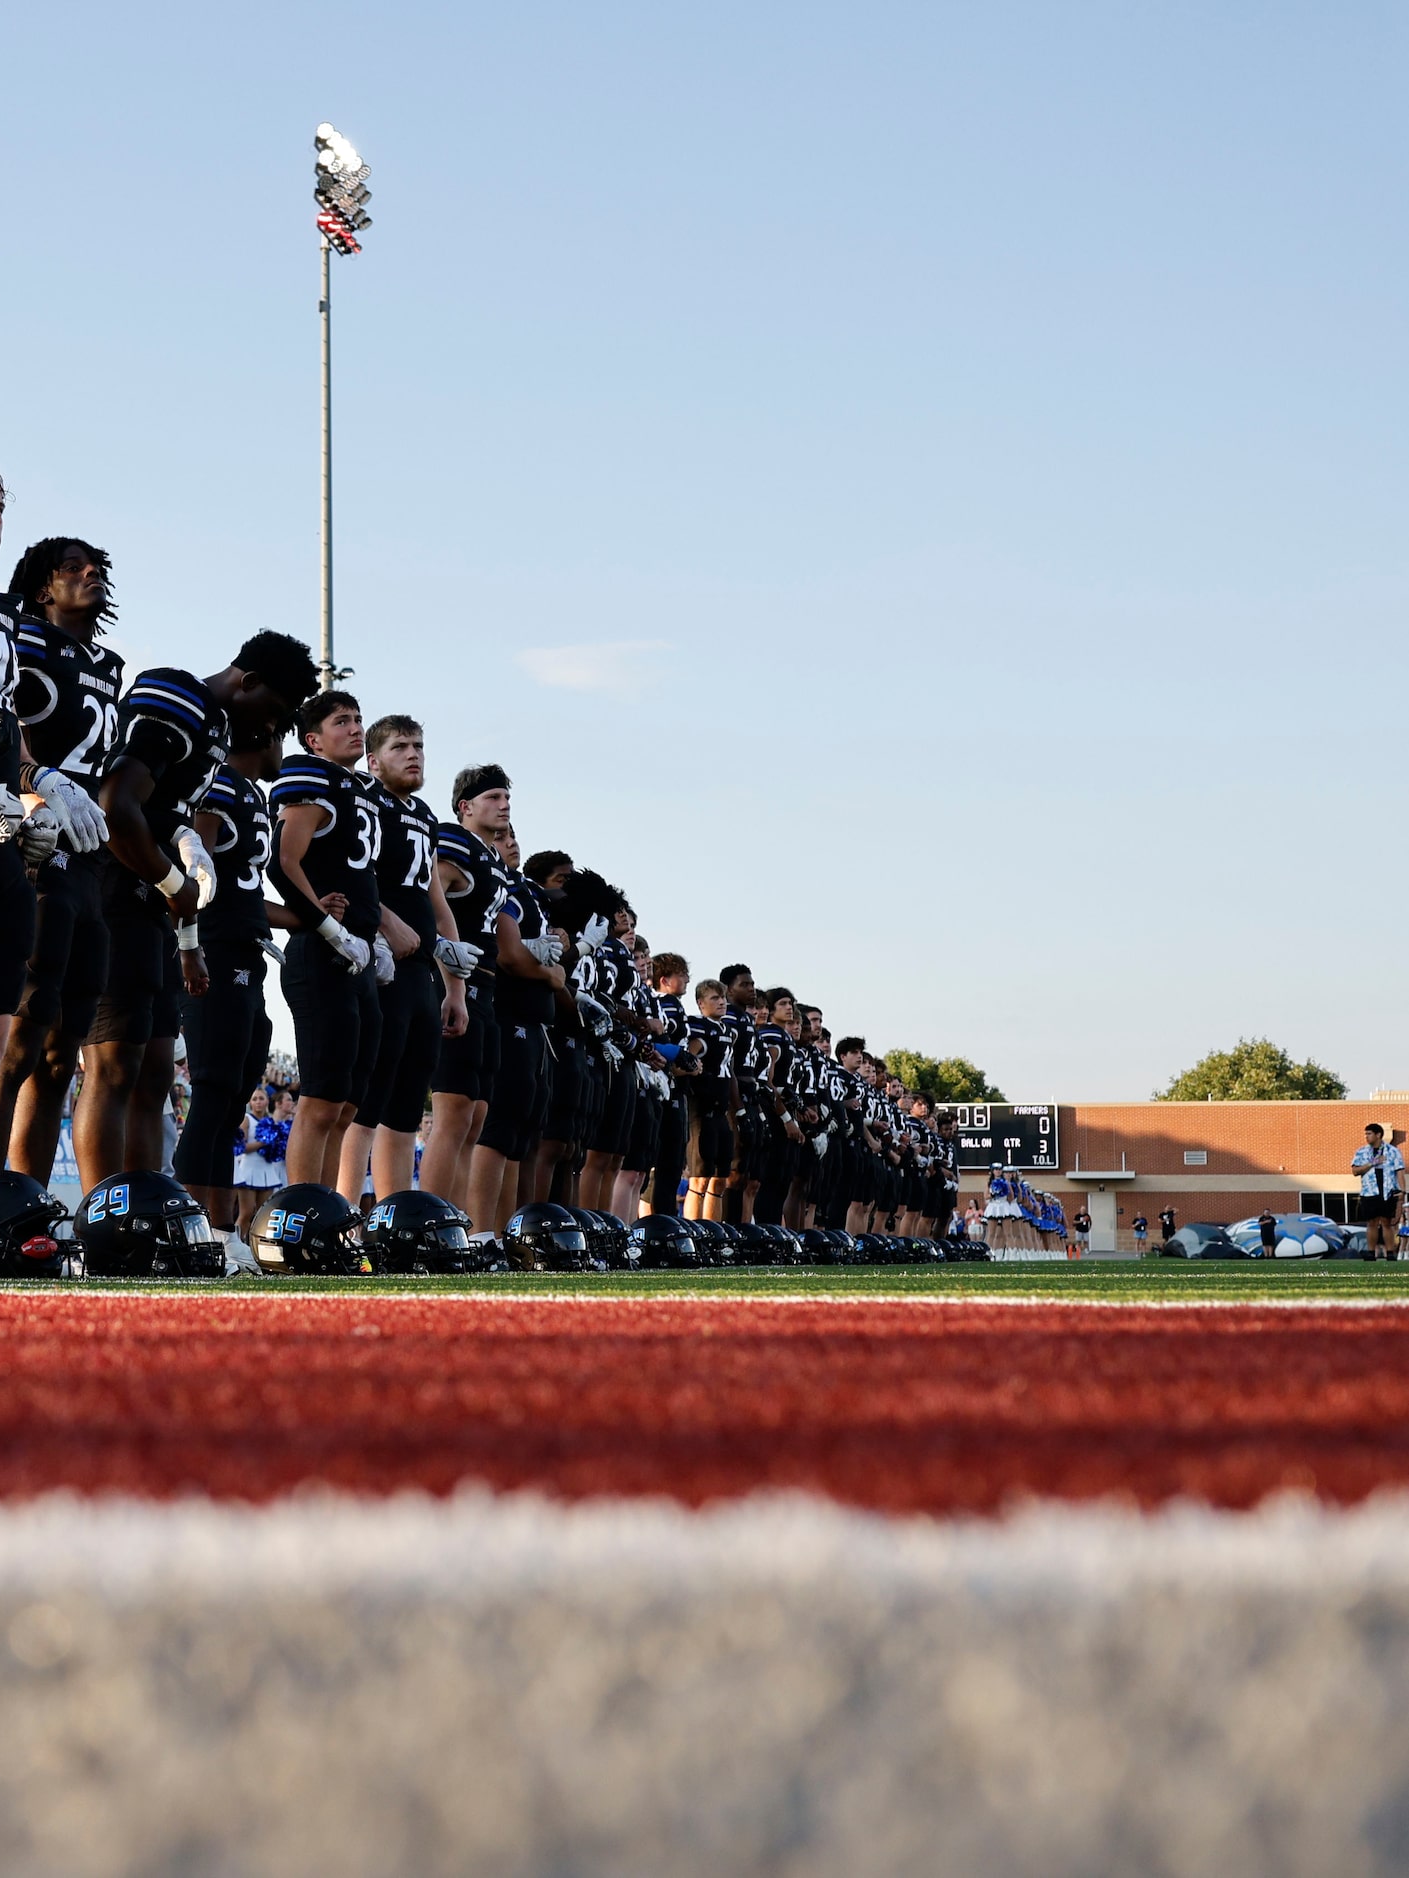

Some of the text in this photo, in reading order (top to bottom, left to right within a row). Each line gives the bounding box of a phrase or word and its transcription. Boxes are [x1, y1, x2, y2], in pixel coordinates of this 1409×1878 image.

[237, 829, 269, 890] 3
[1014, 1106, 1049, 1115] FARMERS
[1039, 1116, 1050, 1134] 0
[961, 1138, 992, 1148] BALL ON
[1004, 1138, 1021, 1148] QTR
[1040, 1140, 1048, 1154] 3
[1007, 1149, 1012, 1165] 1
[88, 1184, 130, 1224] 29
[265, 1209, 306, 1244] 35
[367, 1205, 396, 1232] 34
